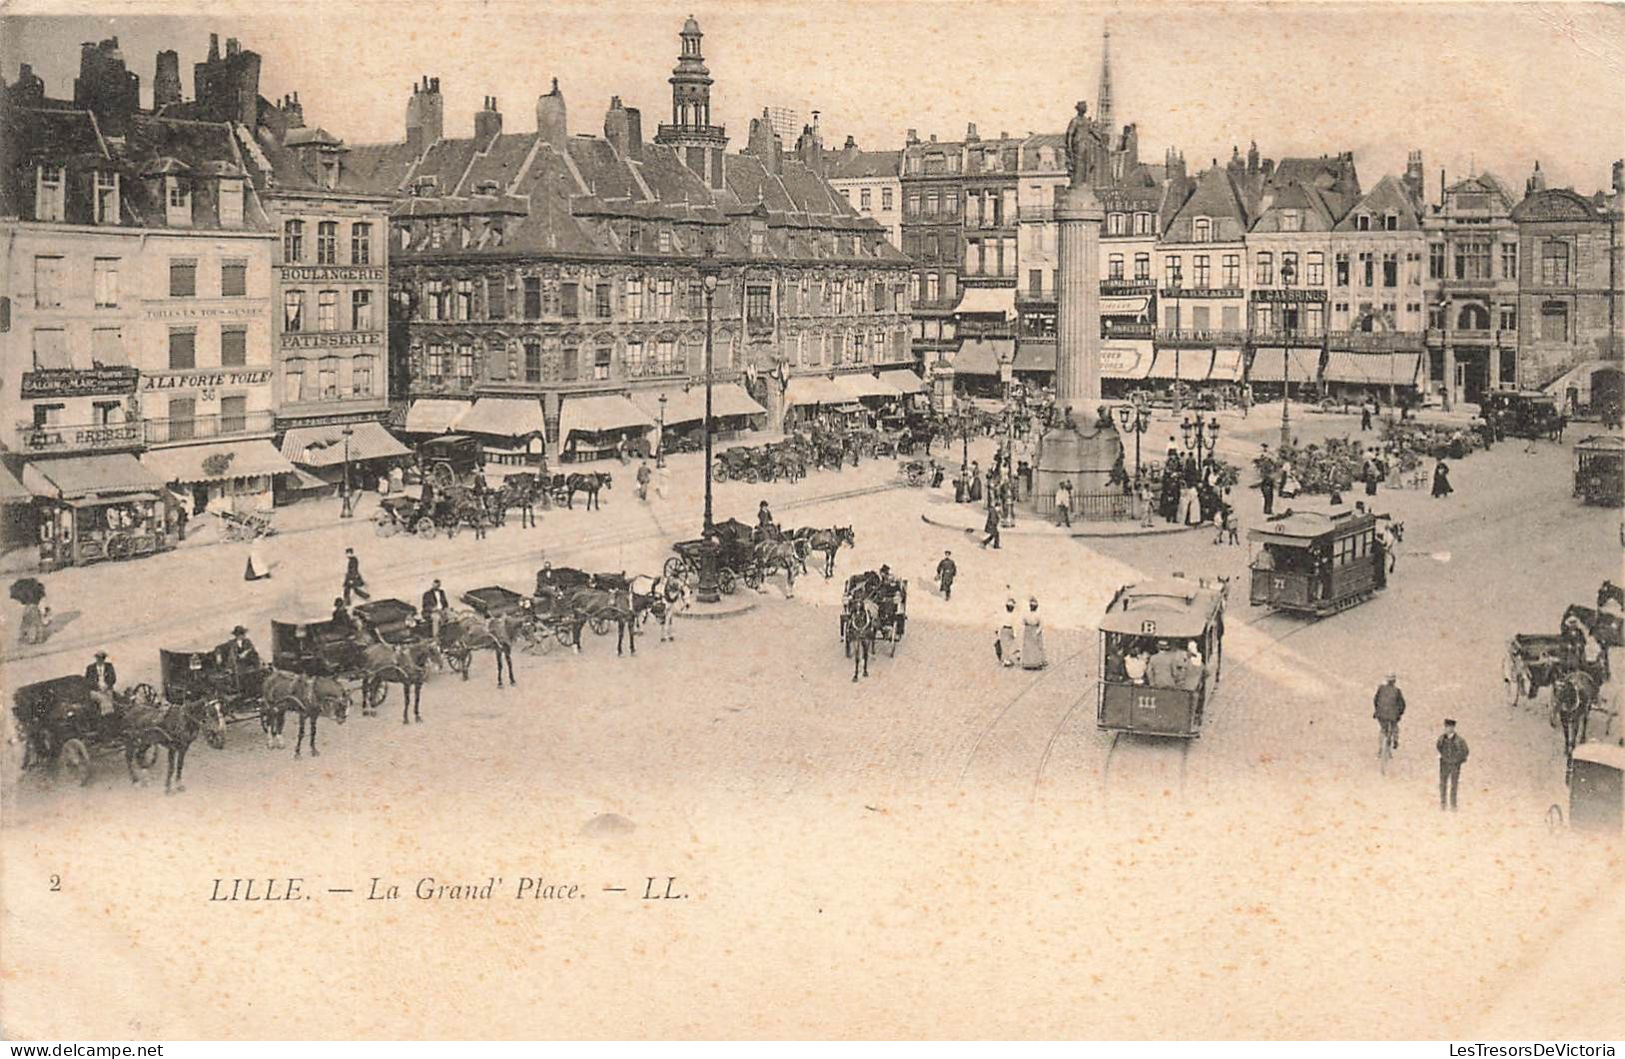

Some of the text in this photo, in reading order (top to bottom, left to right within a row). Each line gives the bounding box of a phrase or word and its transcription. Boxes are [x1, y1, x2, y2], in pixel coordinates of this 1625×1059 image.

[281, 268, 383, 280] BOULANGERIE
[1163, 290, 1243, 298] PHARMACIE
[282, 334, 380, 347] PATISSERIE
[157, 376, 175, 390] LA
[179, 373, 225, 387] FORTE
